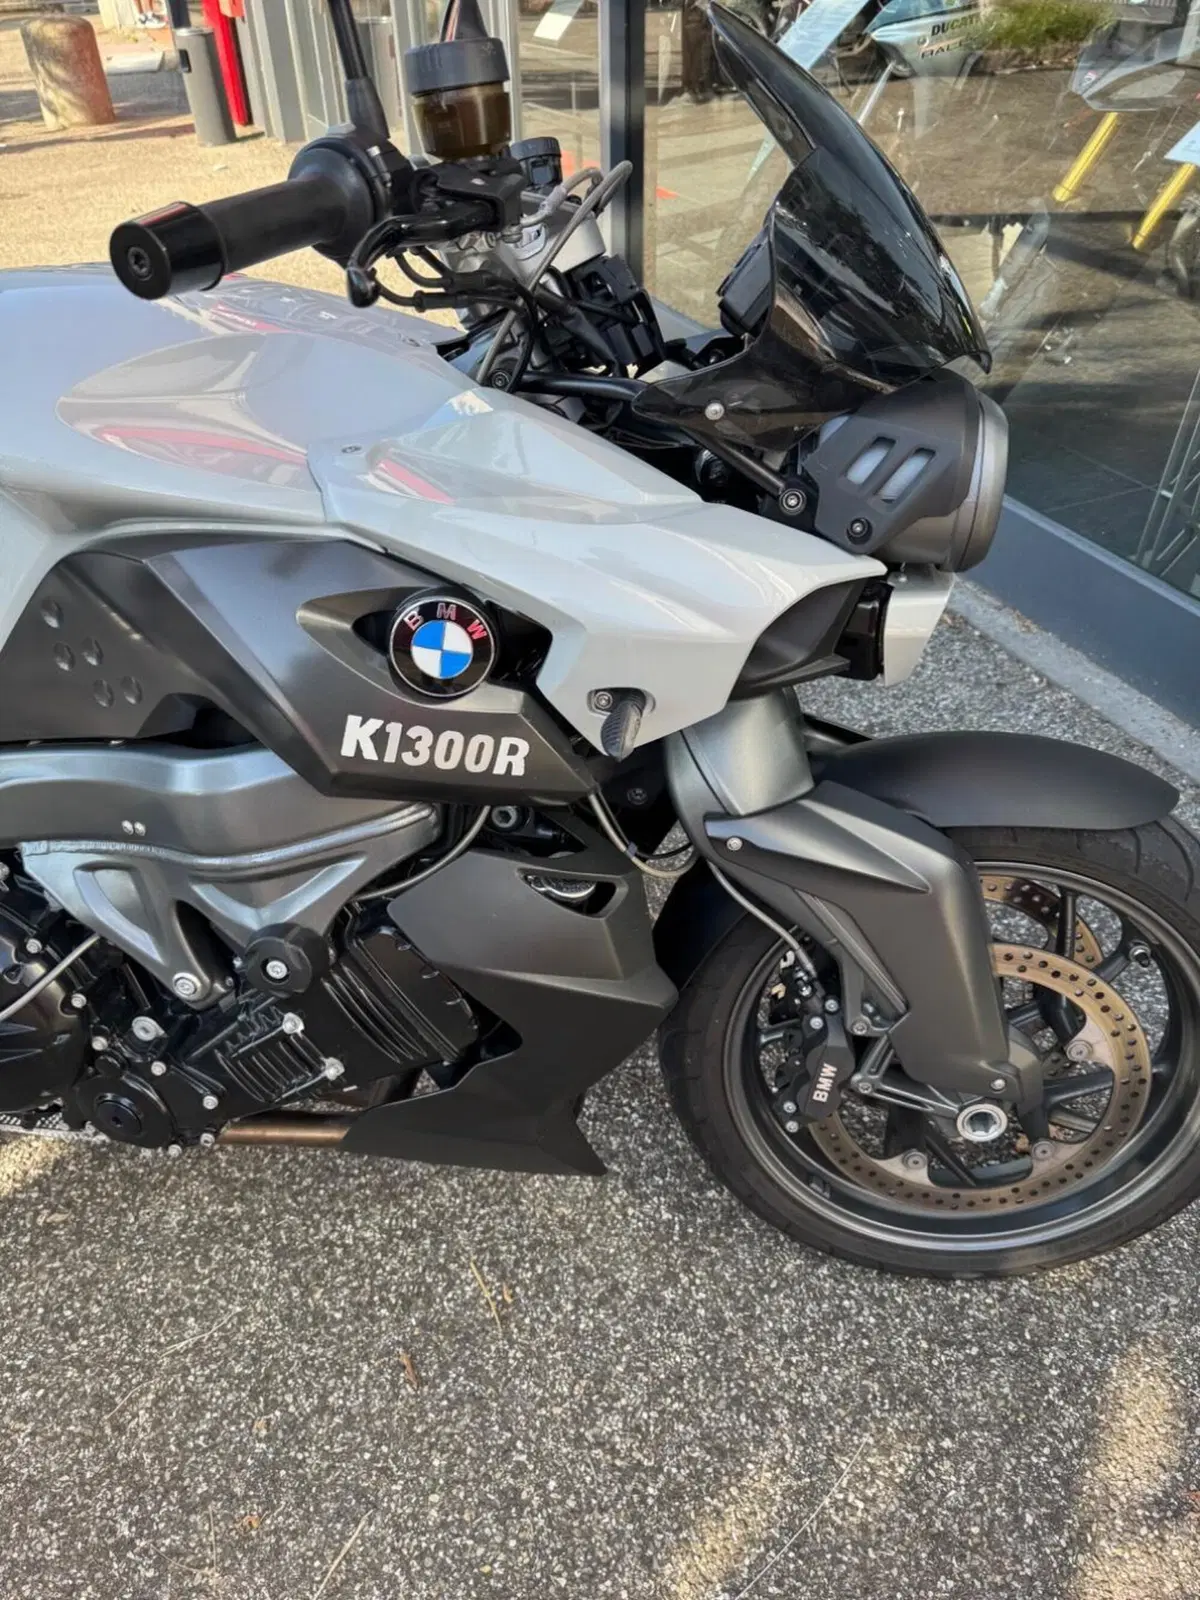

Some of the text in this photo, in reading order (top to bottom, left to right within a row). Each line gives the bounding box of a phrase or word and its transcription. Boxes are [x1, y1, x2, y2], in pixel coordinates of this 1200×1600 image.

[404, 602, 487, 640] BMW
[340, 714, 530, 776] K1300R
[812, 1062, 837, 1103] BMW
